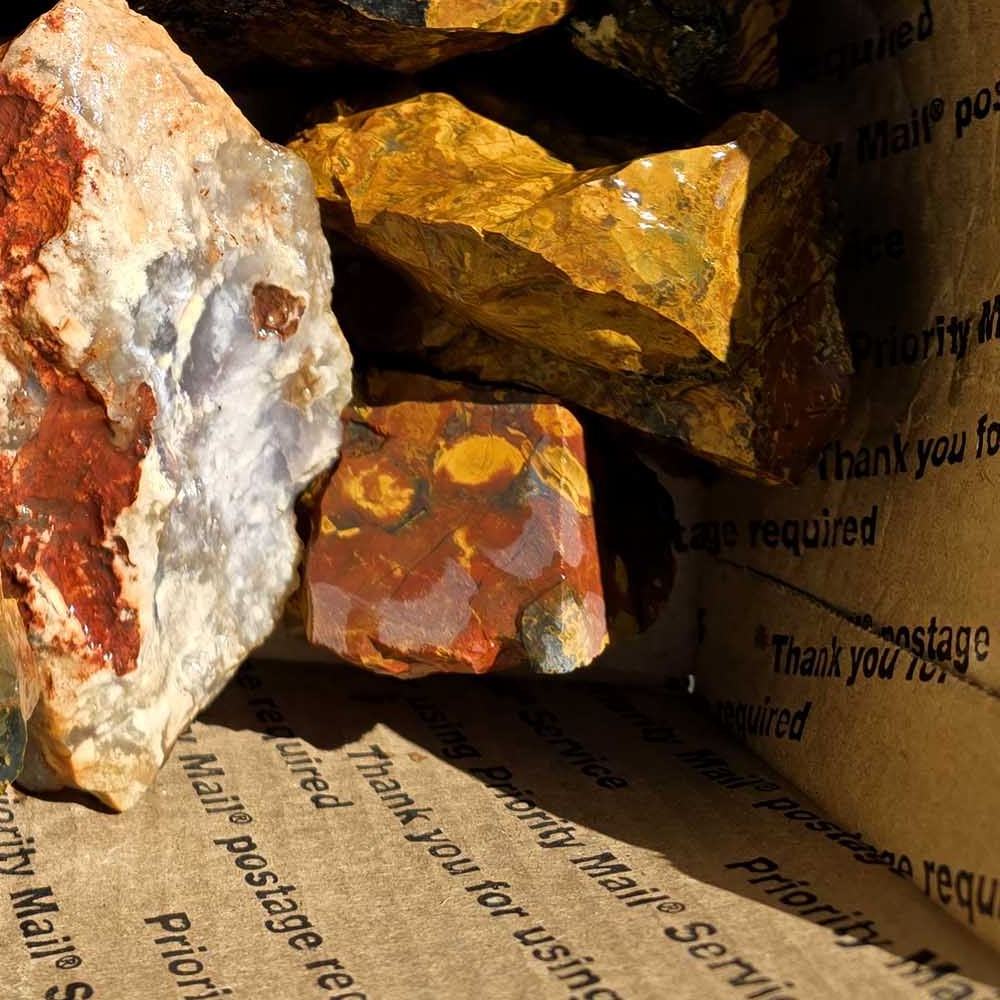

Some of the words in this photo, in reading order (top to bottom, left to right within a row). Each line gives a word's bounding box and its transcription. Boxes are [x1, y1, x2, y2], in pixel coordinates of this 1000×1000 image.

[912, 431, 967, 481] you
[748, 505, 879, 557] required
[770, 633, 841, 679] Thank
[845, 647, 903, 688] you
[346, 742, 434, 827] Thank
[403, 827, 482, 877] you
[464, 879, 531, 918] for
[212, 834, 325, 952] postage
[469, 765, 587, 850] Priority
[663, 920, 797, 1000] Servi
[723, 855, 895, 949] Priority
[8, 886, 83, 970] Mail®
